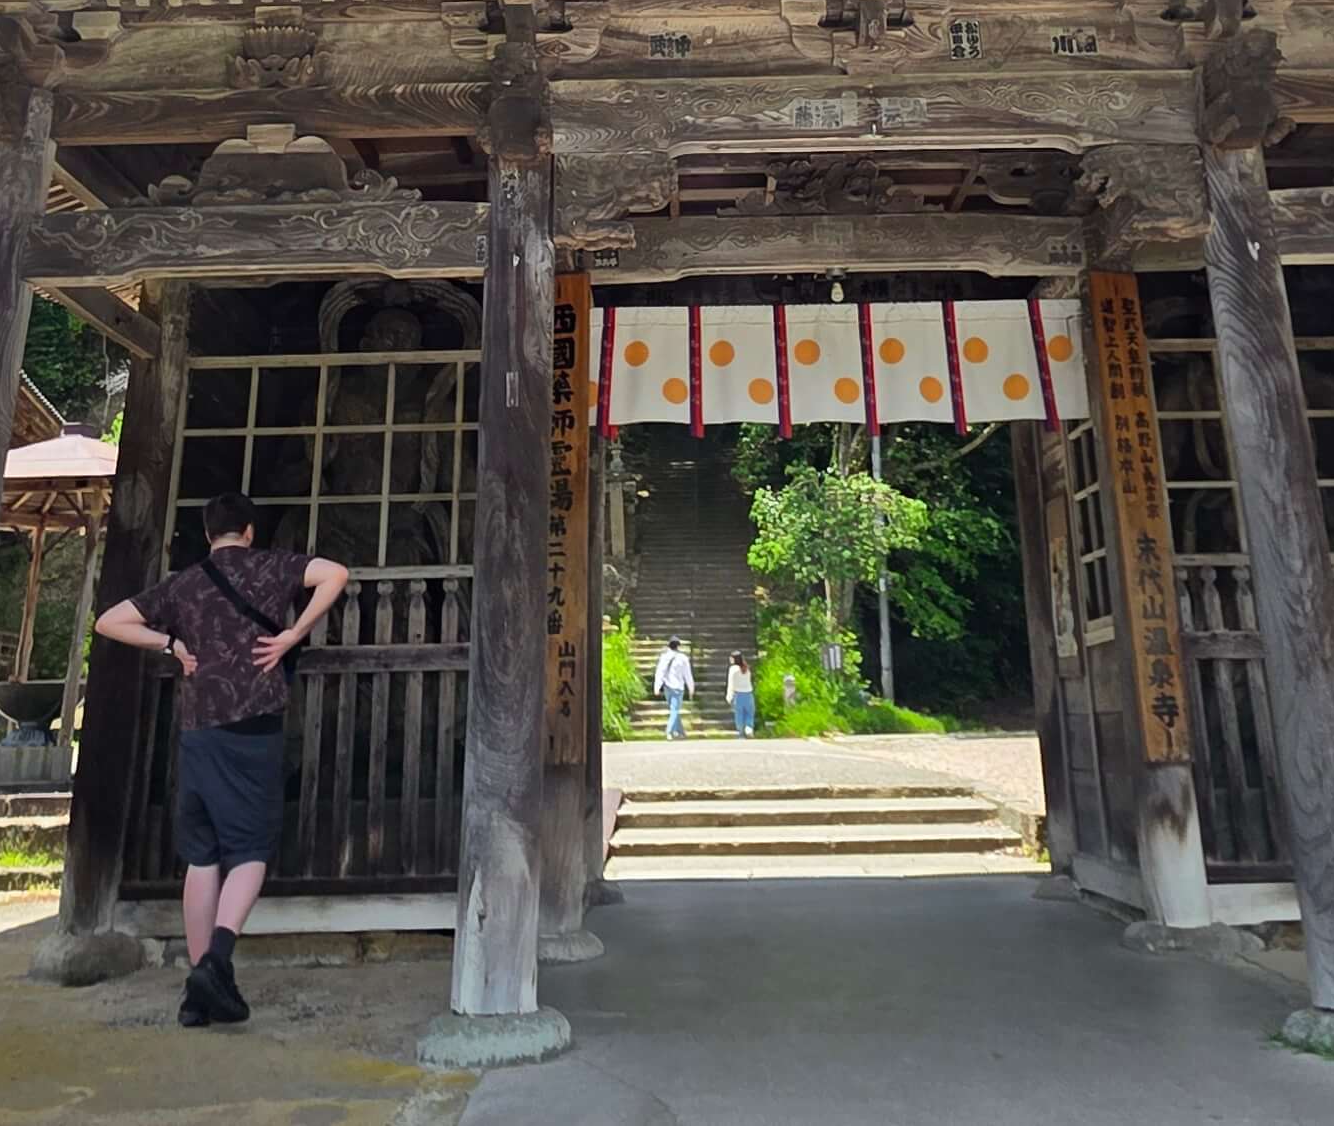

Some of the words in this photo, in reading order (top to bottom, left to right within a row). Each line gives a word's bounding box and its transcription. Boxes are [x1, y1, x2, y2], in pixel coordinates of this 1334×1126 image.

[557, 640, 576, 718] 山門入る
[1134, 530, 1181, 730] 末代山温泉寺
